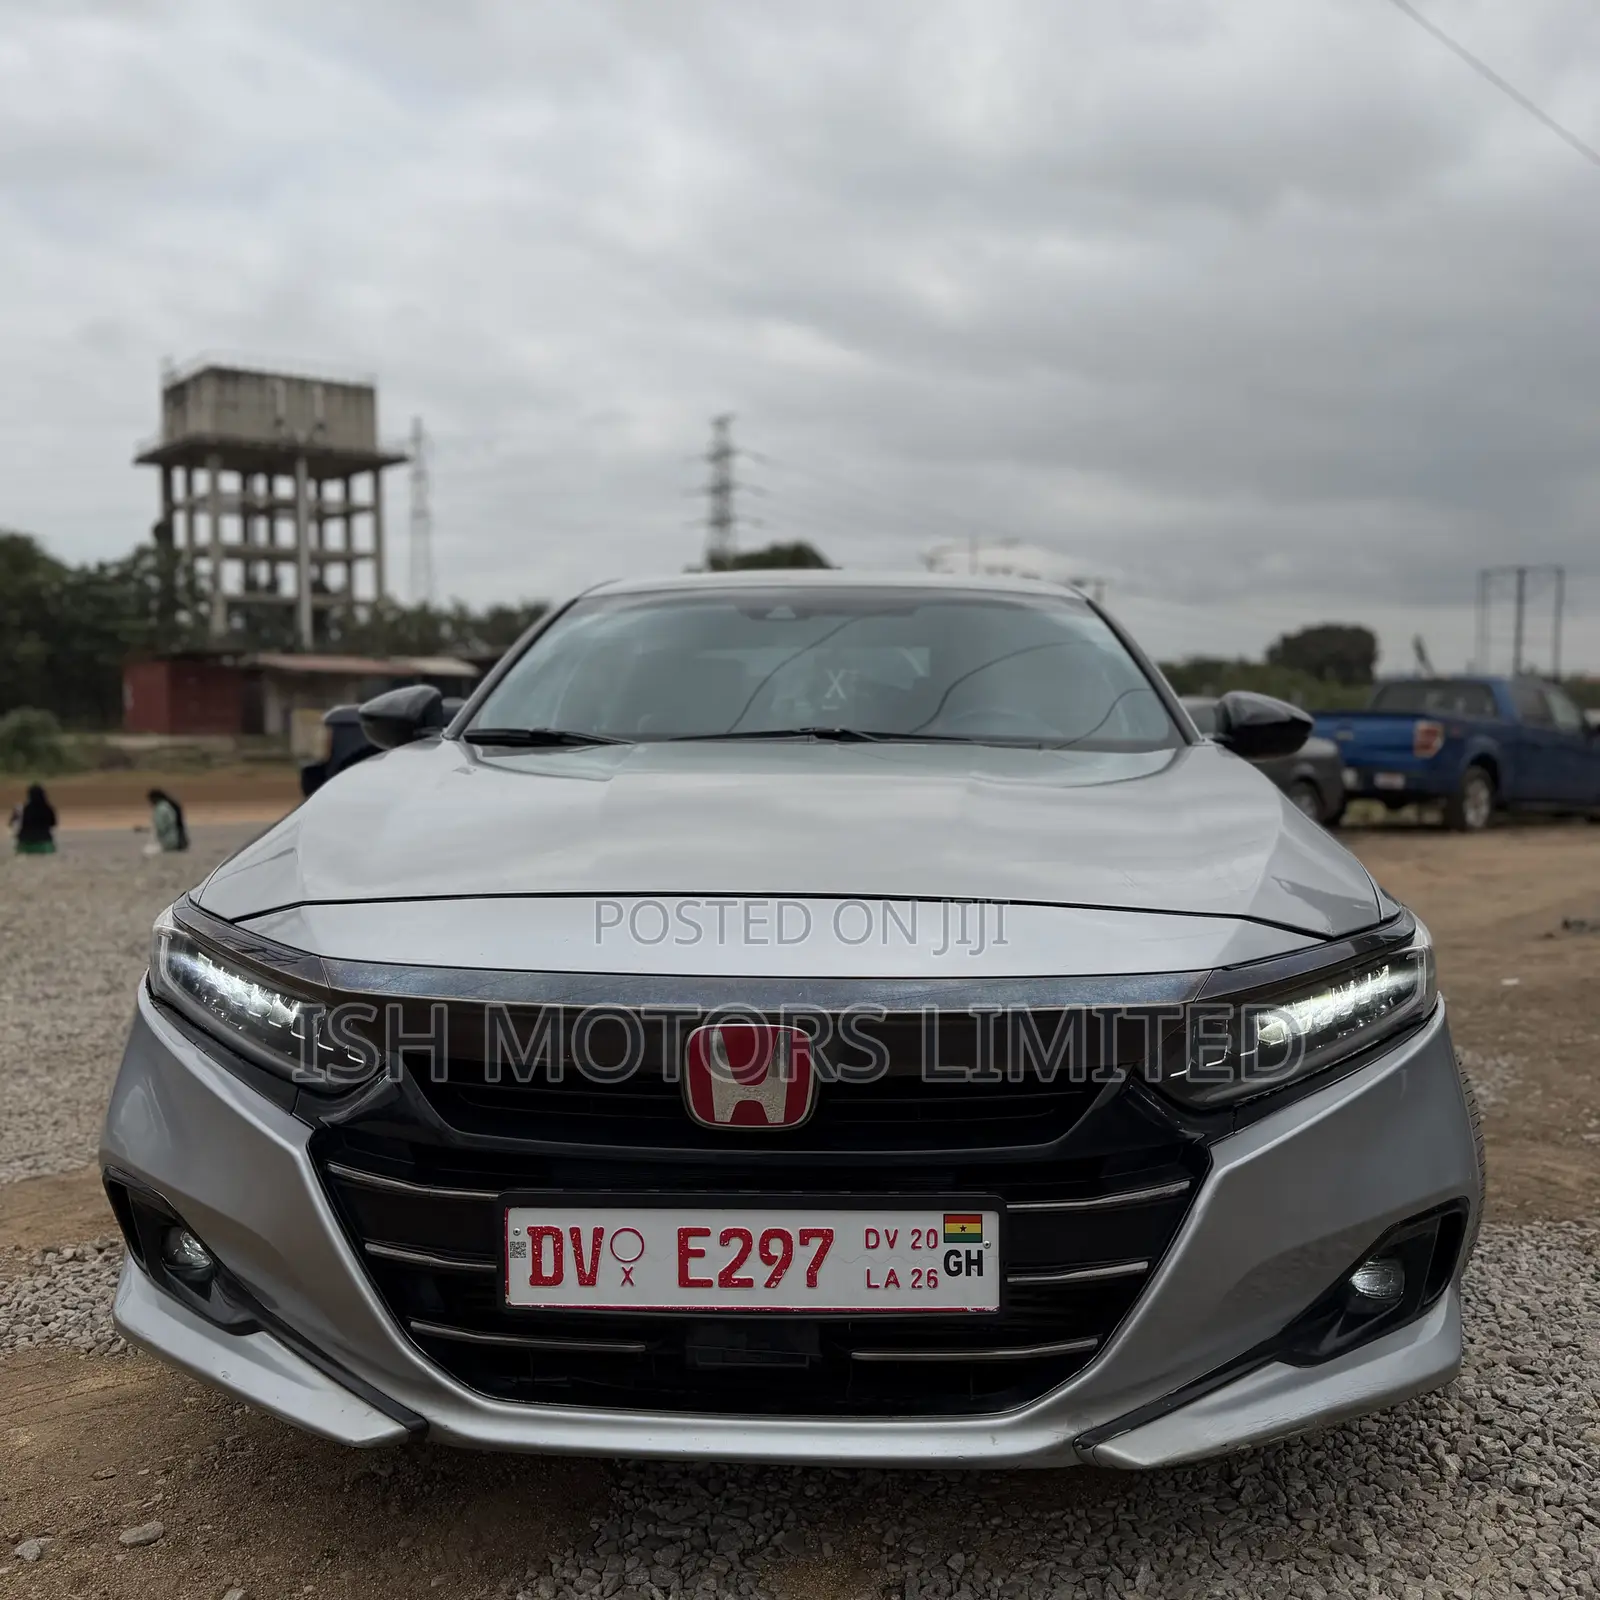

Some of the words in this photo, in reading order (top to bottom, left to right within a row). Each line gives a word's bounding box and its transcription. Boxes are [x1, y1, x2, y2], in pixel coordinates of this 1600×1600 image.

[865, 1228, 899, 1249] DV
[911, 1228, 939, 1250] 20
[527, 1226, 604, 1287] DV
[677, 1227, 835, 1289] E297
[943, 1249, 984, 1277] GH
[866, 1268, 901, 1289] LA
[911, 1268, 939, 1289] 26
